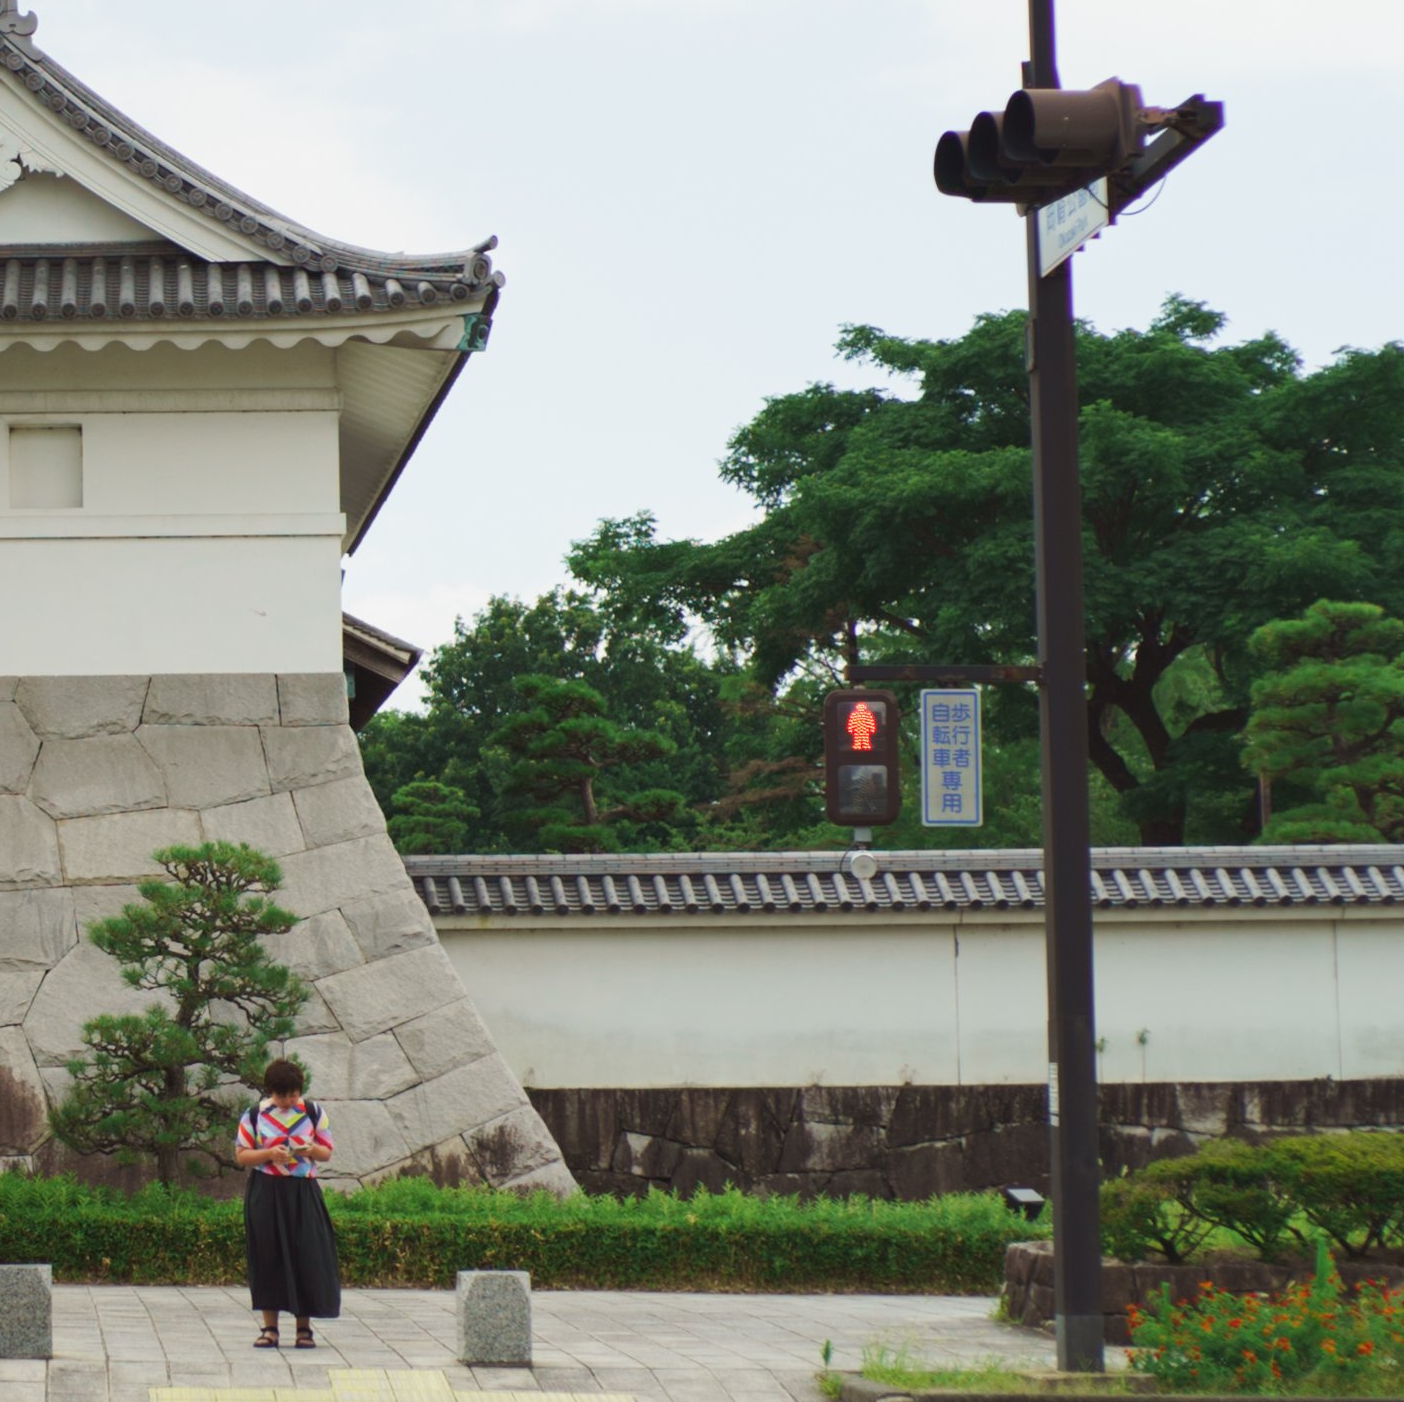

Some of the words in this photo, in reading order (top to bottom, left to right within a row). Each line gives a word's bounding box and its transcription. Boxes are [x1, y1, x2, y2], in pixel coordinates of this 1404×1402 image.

[932, 703, 951, 768] 自転車
[951, 702, 971, 768] 歩行者
[941, 770, 963, 813] 専用
